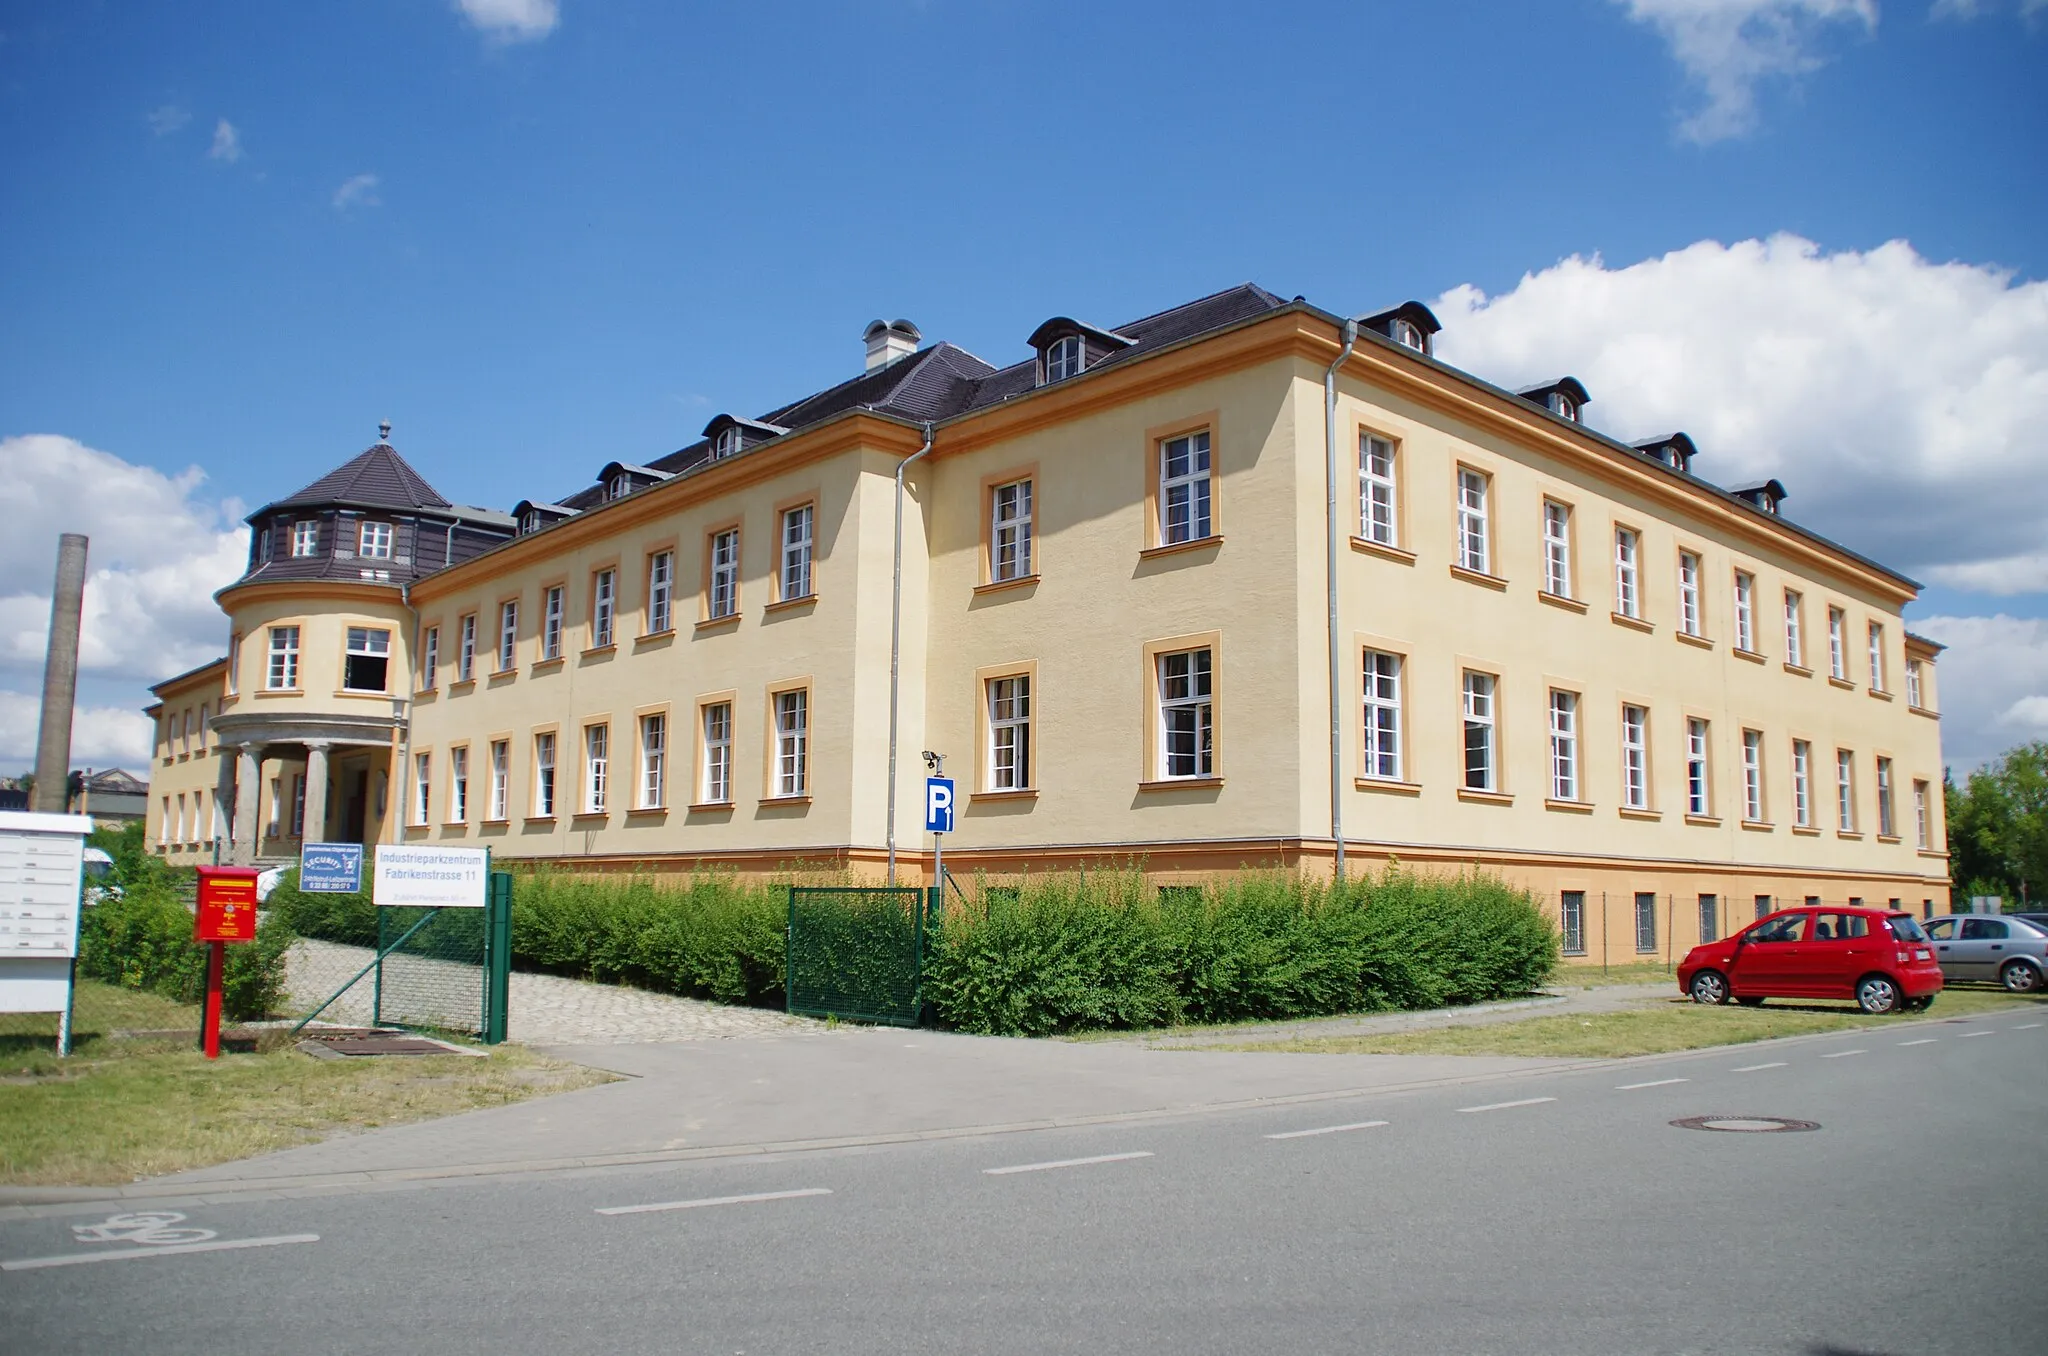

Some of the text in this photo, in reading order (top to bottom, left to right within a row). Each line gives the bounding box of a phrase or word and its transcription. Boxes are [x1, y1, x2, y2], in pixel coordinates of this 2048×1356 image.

[928, 784, 952, 824] P
[304, 856, 342, 869] SECURITY
[380, 852, 481, 866] Industrieparkzentrum
[385, 868, 477, 881] Fabrikenstrasse 11
